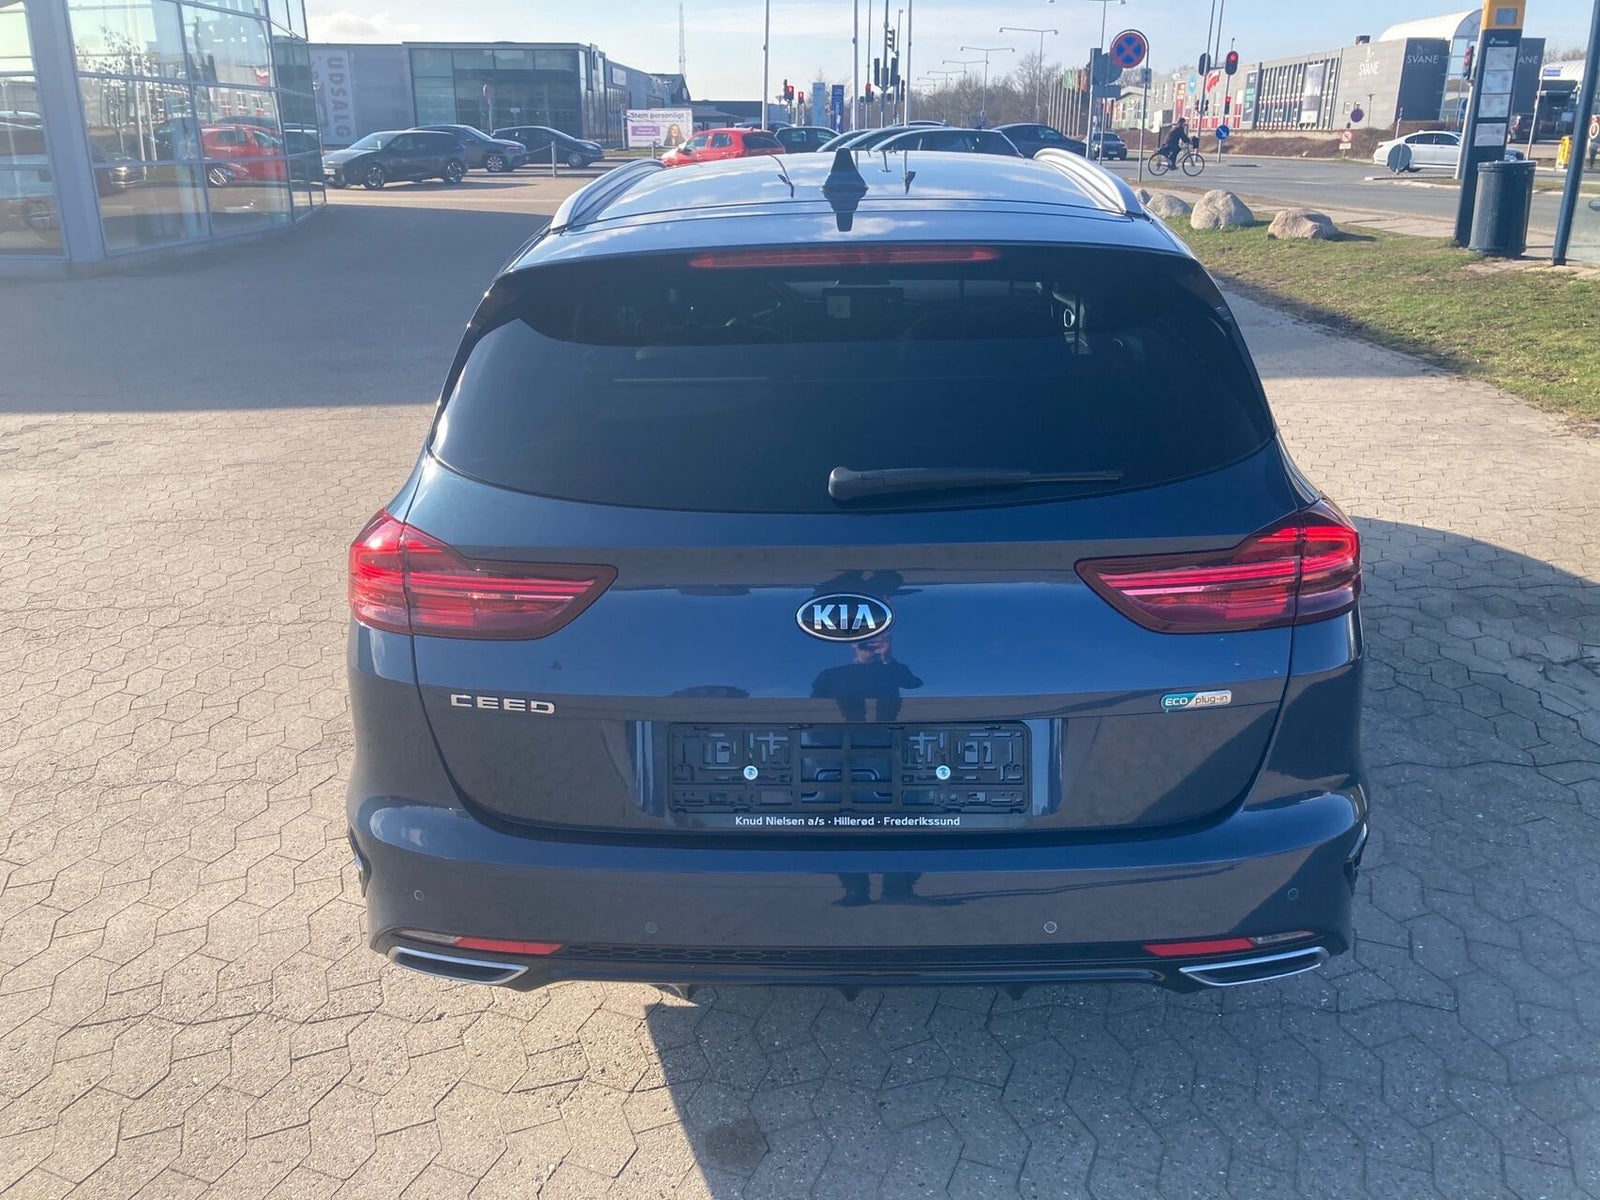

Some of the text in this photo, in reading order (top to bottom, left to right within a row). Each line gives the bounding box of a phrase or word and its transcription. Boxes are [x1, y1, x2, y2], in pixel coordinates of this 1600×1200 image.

[1407, 55, 1439, 64] SVANE
[1518, 56, 1539, 64] ANE
[1359, 61, 1379, 76] SVANE
[327, 56, 351, 137] UDSALG
[813, 604, 876, 630] KIA
[450, 694, 555, 714] CEED
[1165, 697, 1188, 706] ECO
[735, 816, 960, 826] Knud Nielsen a/s Hillerød Frederikssund
